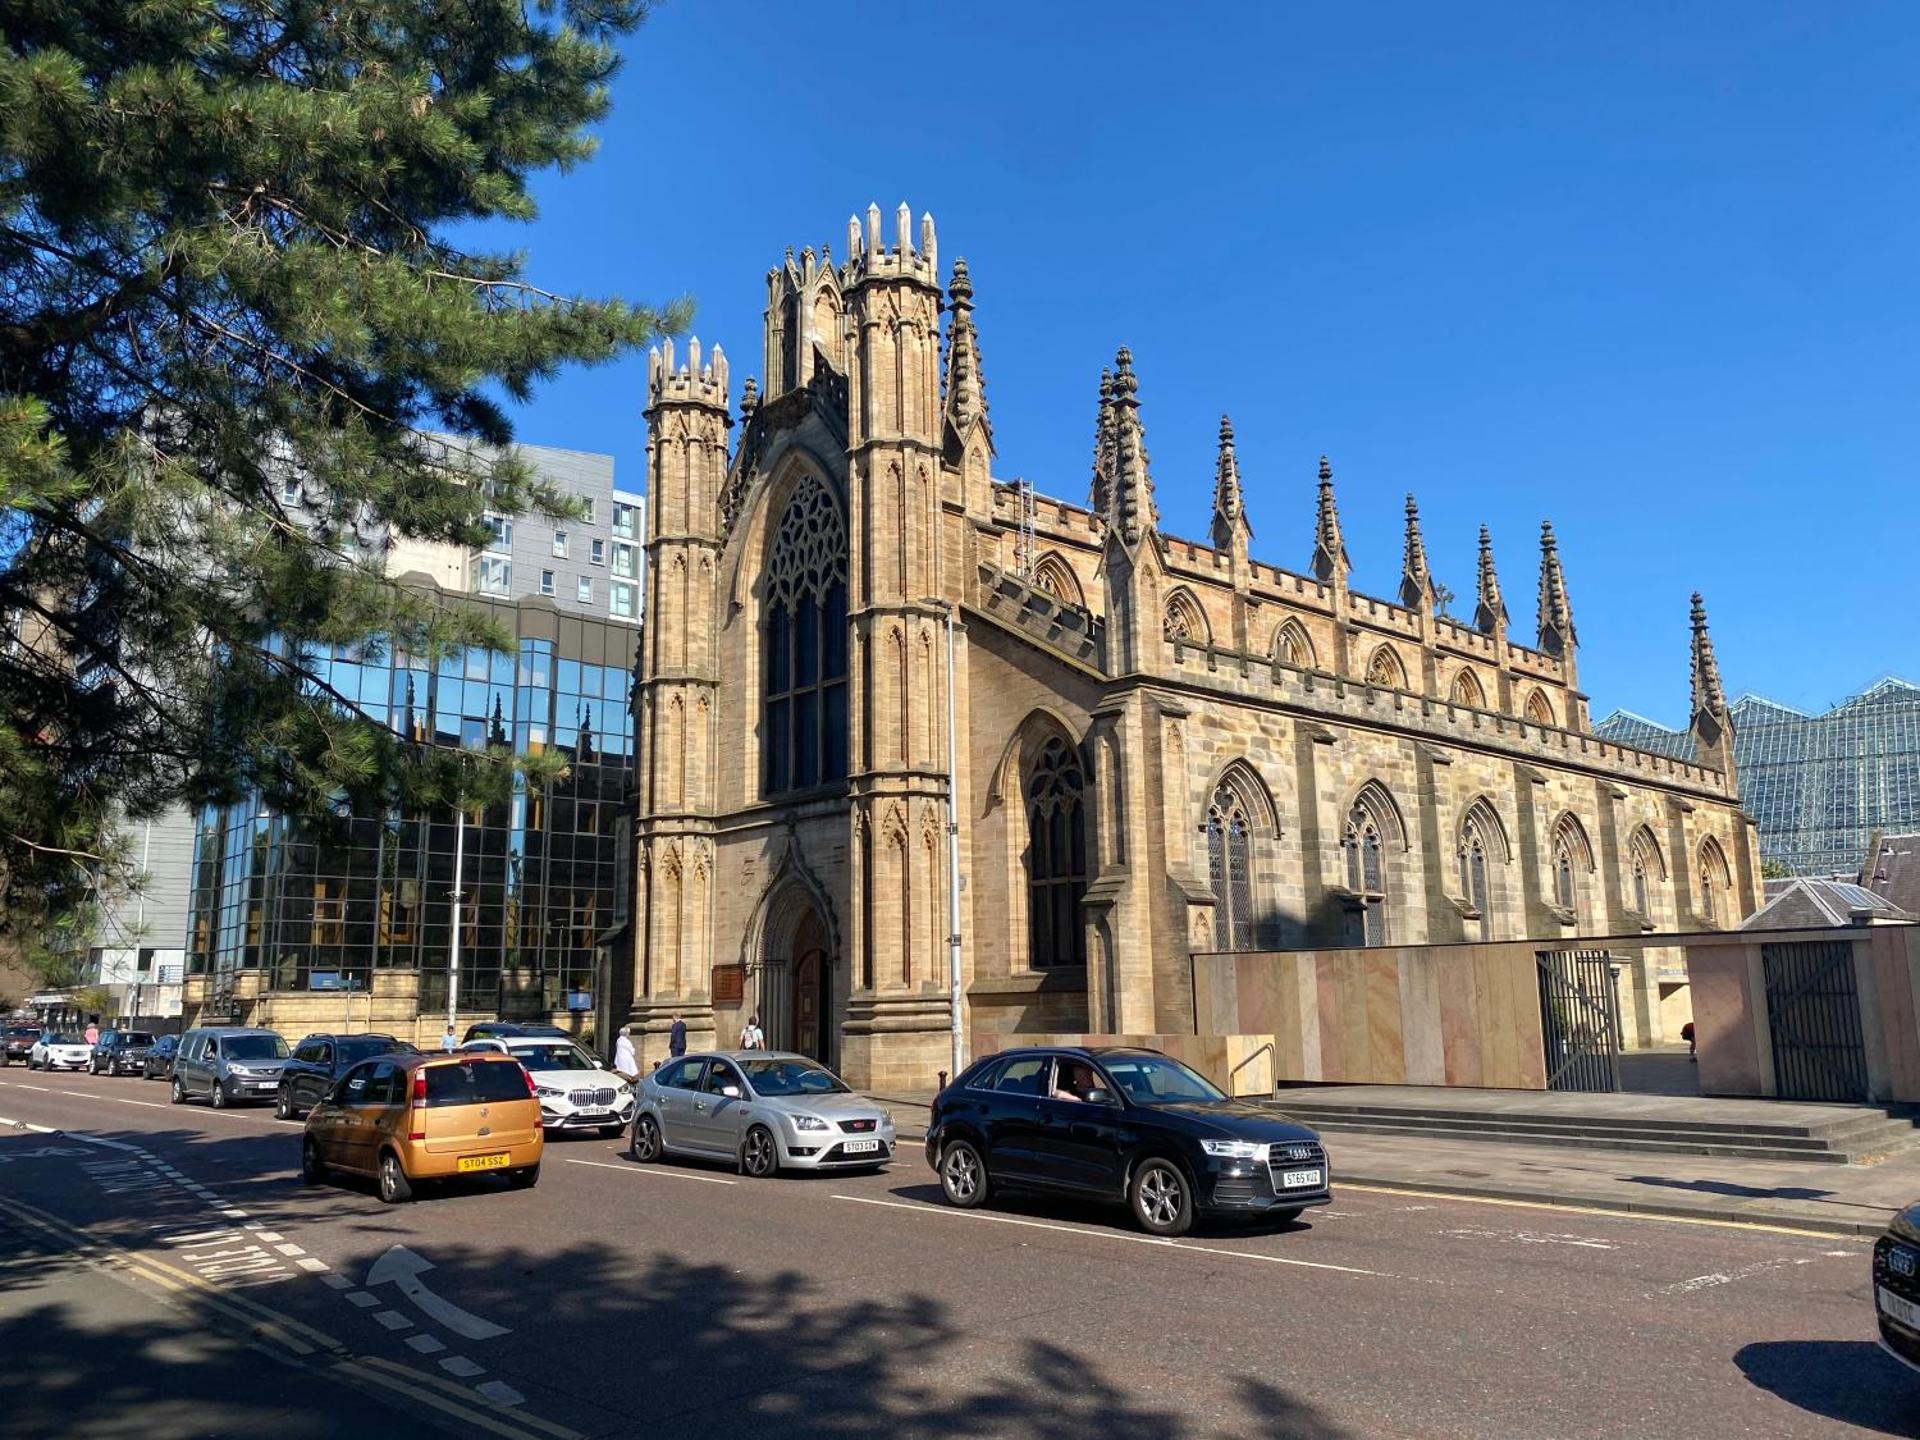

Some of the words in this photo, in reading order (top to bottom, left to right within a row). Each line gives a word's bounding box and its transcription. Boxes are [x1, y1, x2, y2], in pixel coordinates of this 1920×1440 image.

[463, 1158, 486, 1169] ST04
[487, 1156, 505, 1166] SSZ
[1287, 1173, 1305, 1185] ST65
